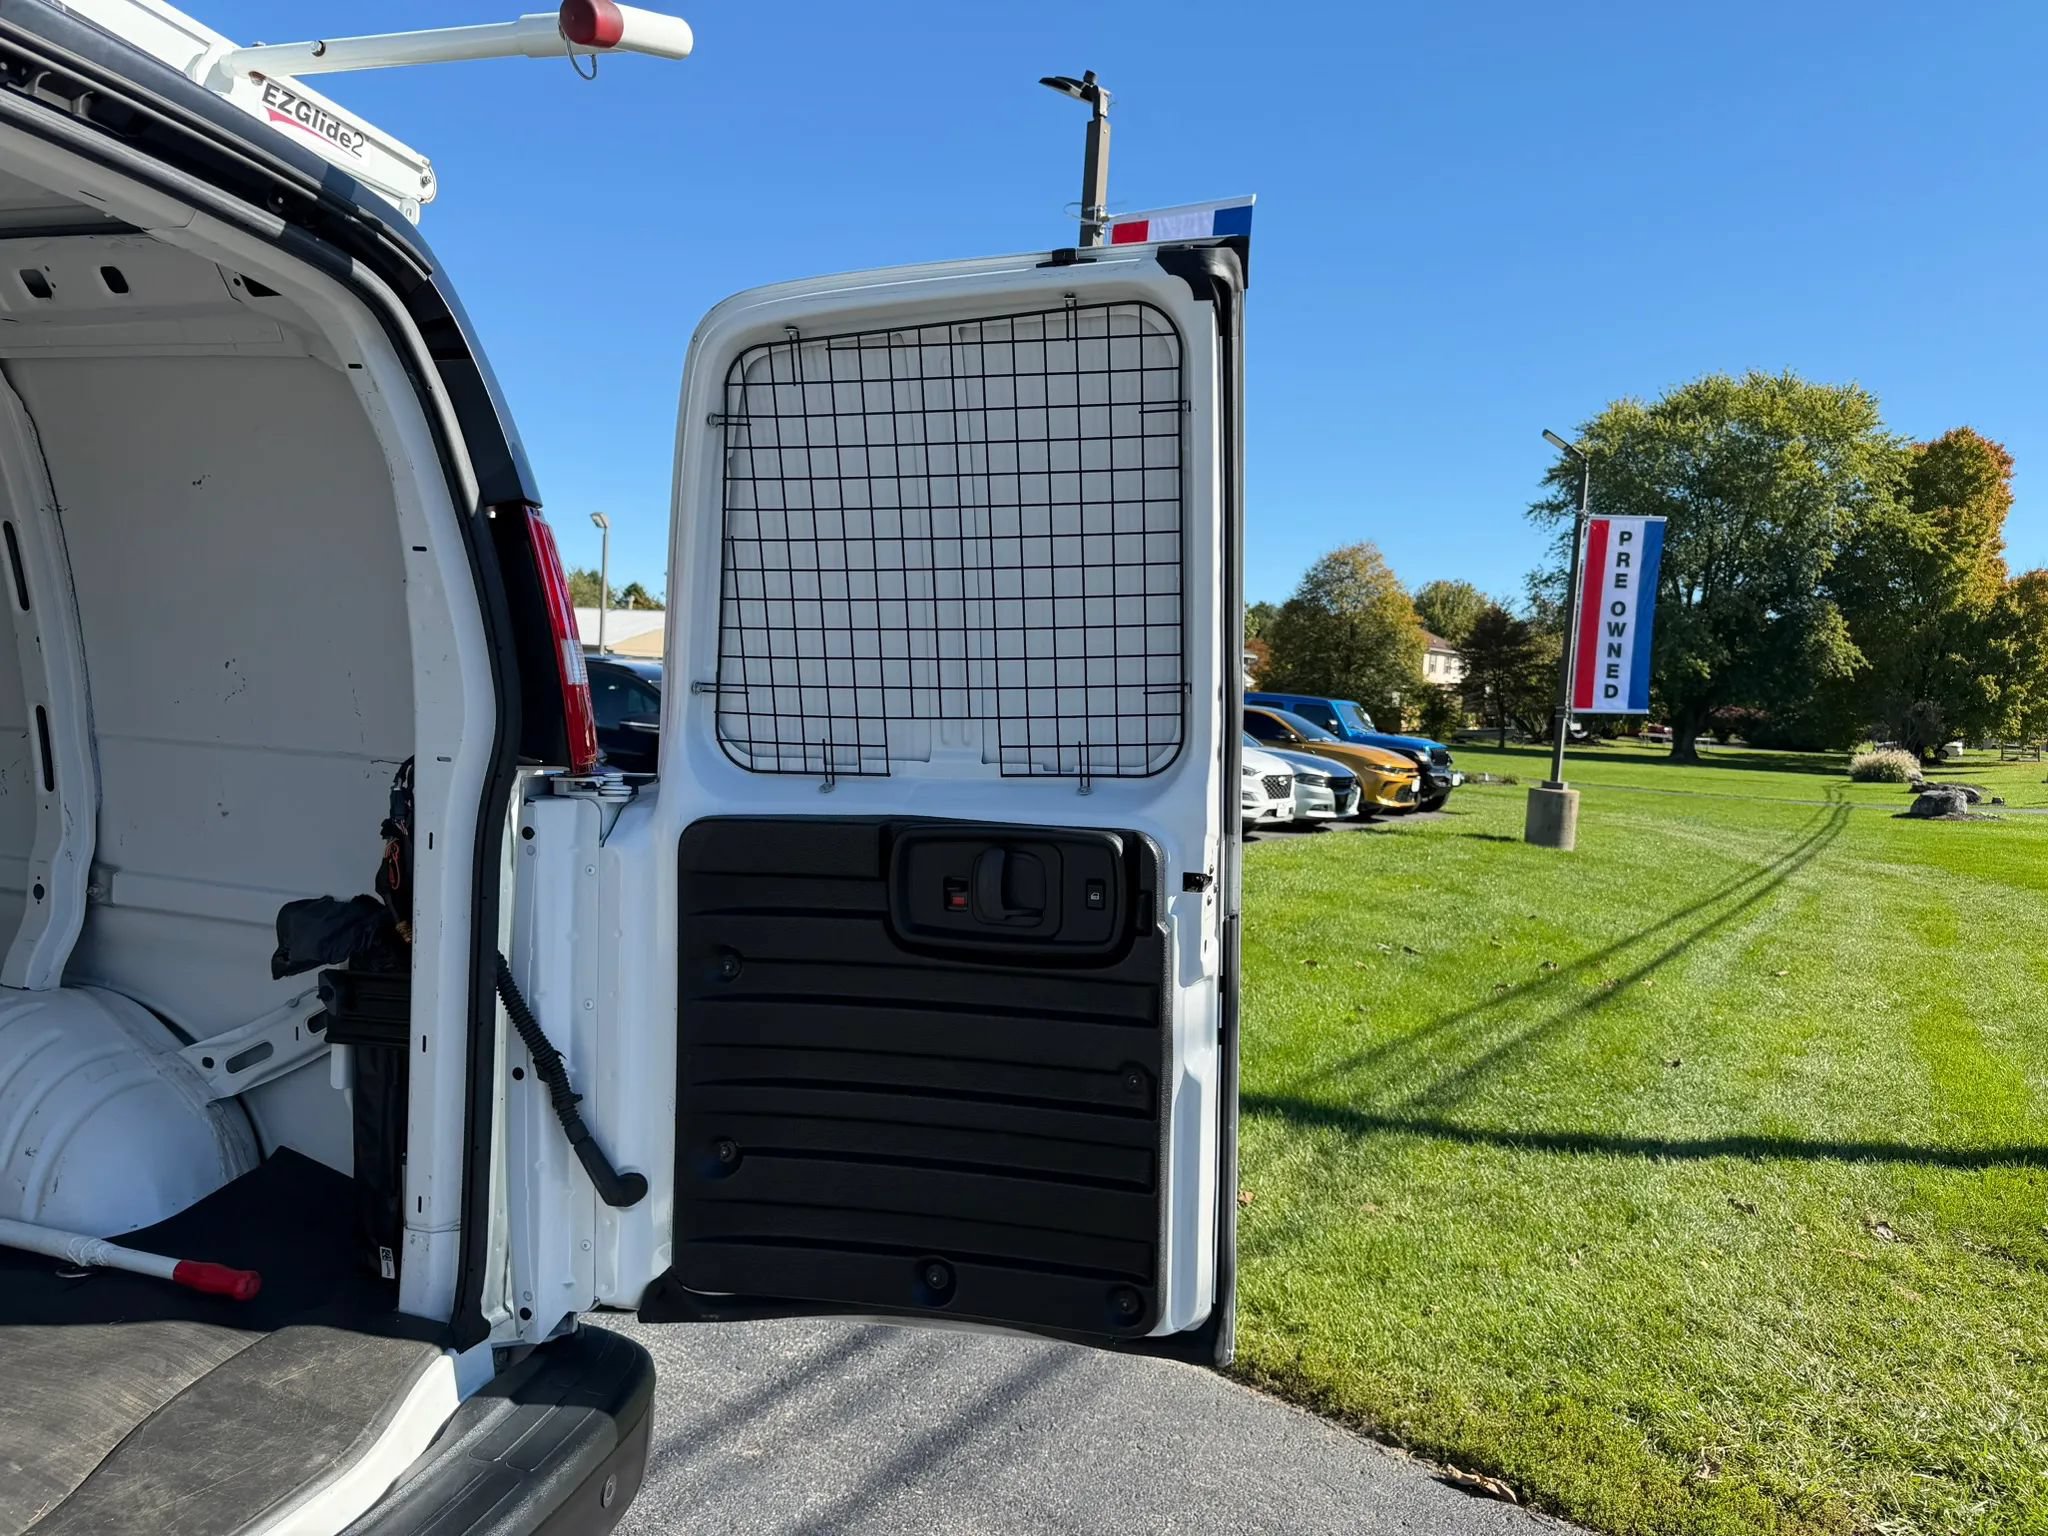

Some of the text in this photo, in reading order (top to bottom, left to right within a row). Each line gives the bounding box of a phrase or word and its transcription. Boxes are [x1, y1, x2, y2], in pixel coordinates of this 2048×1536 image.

[262, 83, 364, 158] EZGlide2
[1604, 531, 1633, 699] PRE OWNED
